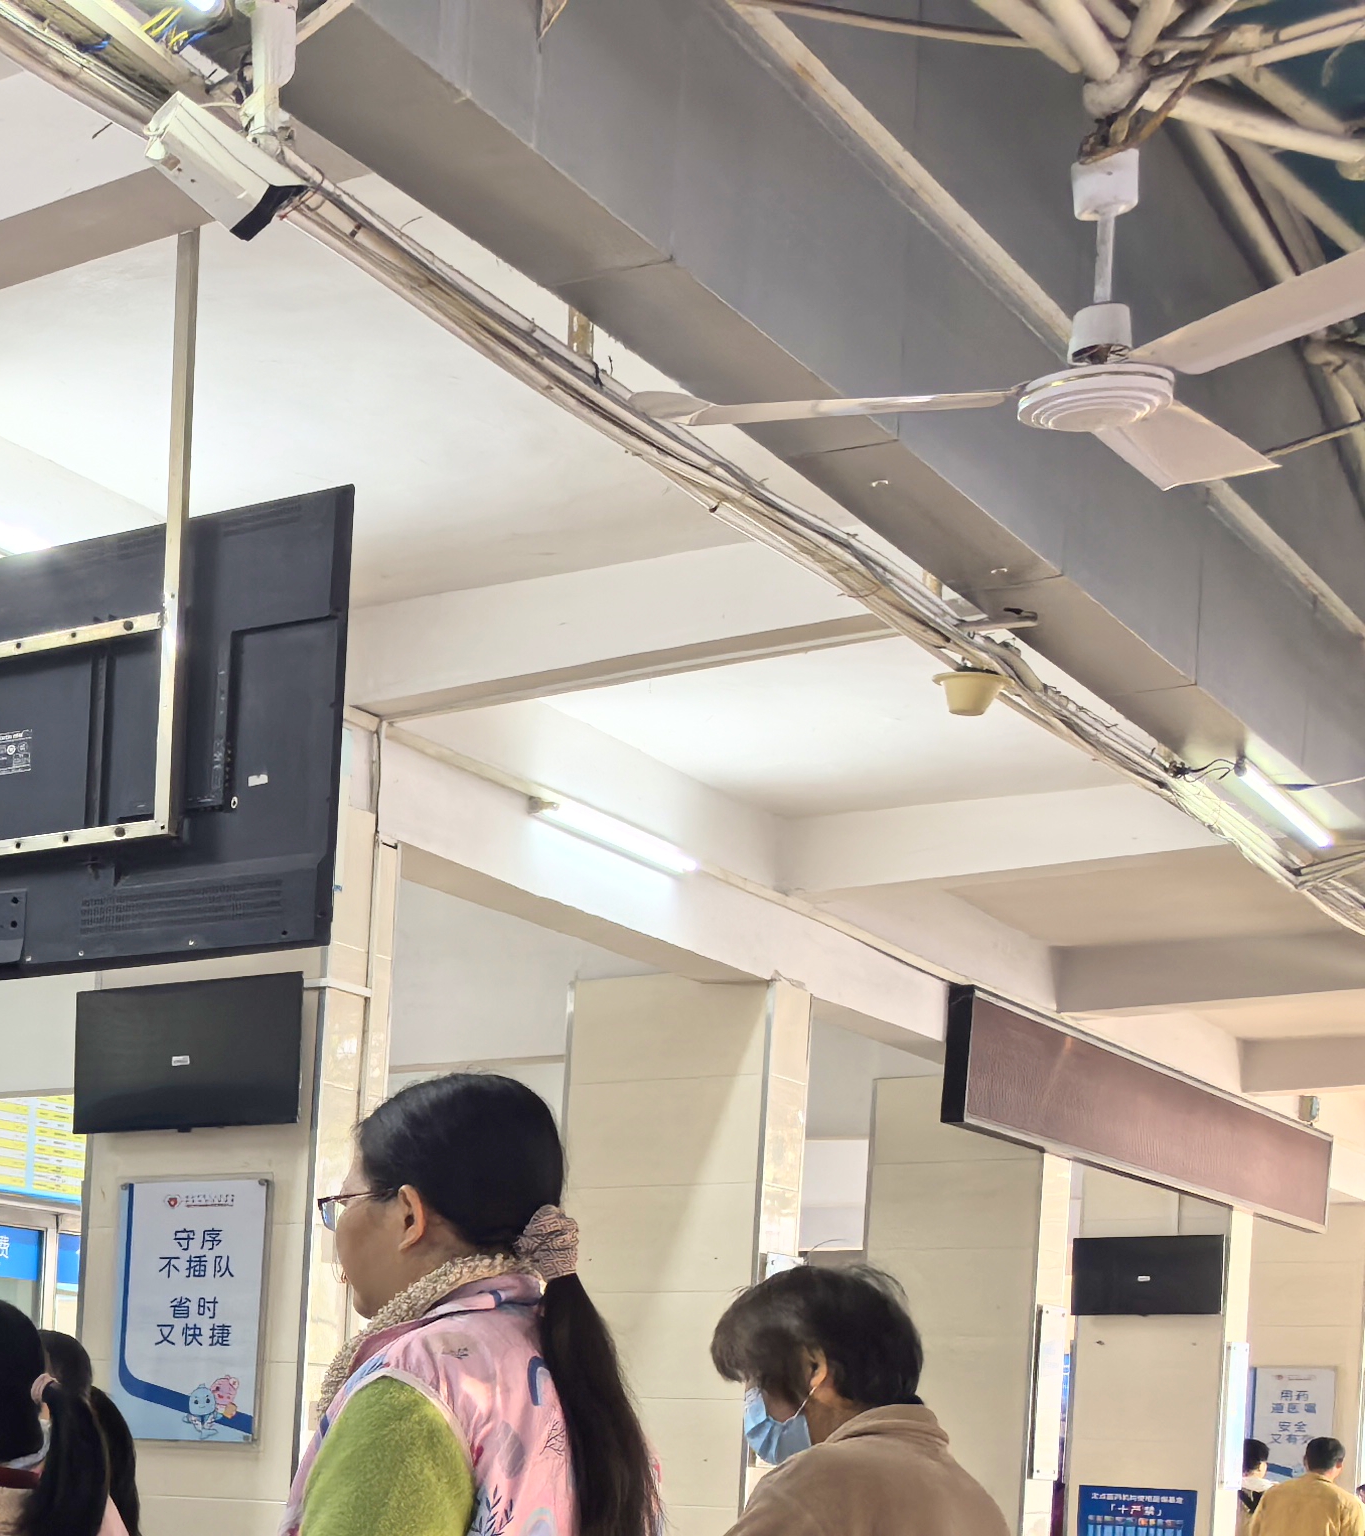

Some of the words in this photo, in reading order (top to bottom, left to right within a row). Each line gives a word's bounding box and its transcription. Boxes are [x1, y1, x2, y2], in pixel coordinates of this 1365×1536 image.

[173, 1228, 224, 1251] 守序
[158, 1254, 235, 1279] 不插队
[169, 1296, 219, 1319] 省时
[155, 1323, 232, 1347] 又快捷
[1280, 1390, 1309, 1401] 用药
[1278, 1421, 1307, 1432] 安全
